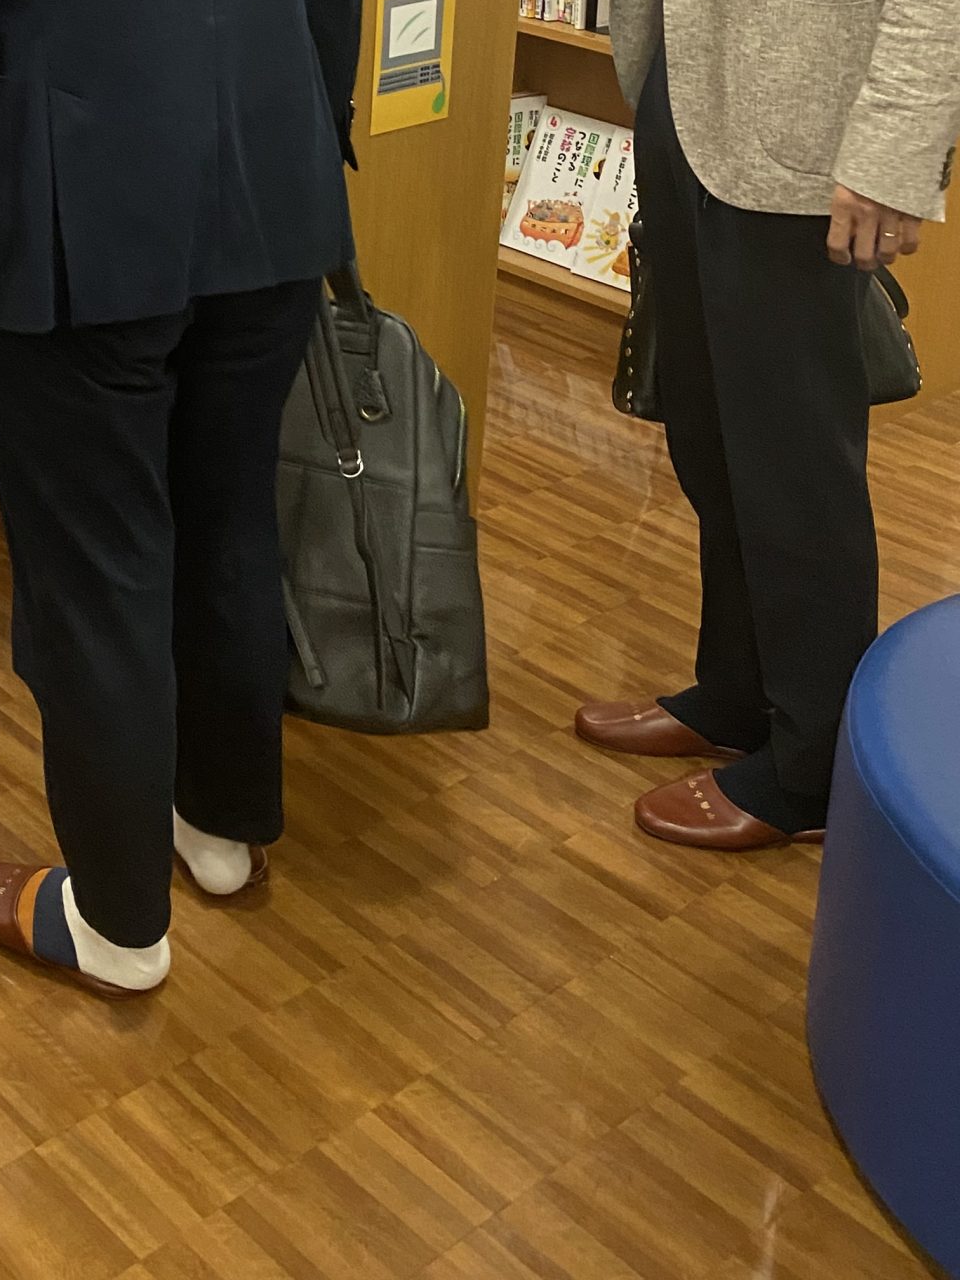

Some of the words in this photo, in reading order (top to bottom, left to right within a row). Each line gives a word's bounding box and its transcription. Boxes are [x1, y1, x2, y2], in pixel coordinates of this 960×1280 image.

[550, 116, 558, 128] 4
[551, 127, 577, 183] 宗教のこと
[568, 131, 587, 172] つながる
[623, 140, 632, 152] 2
